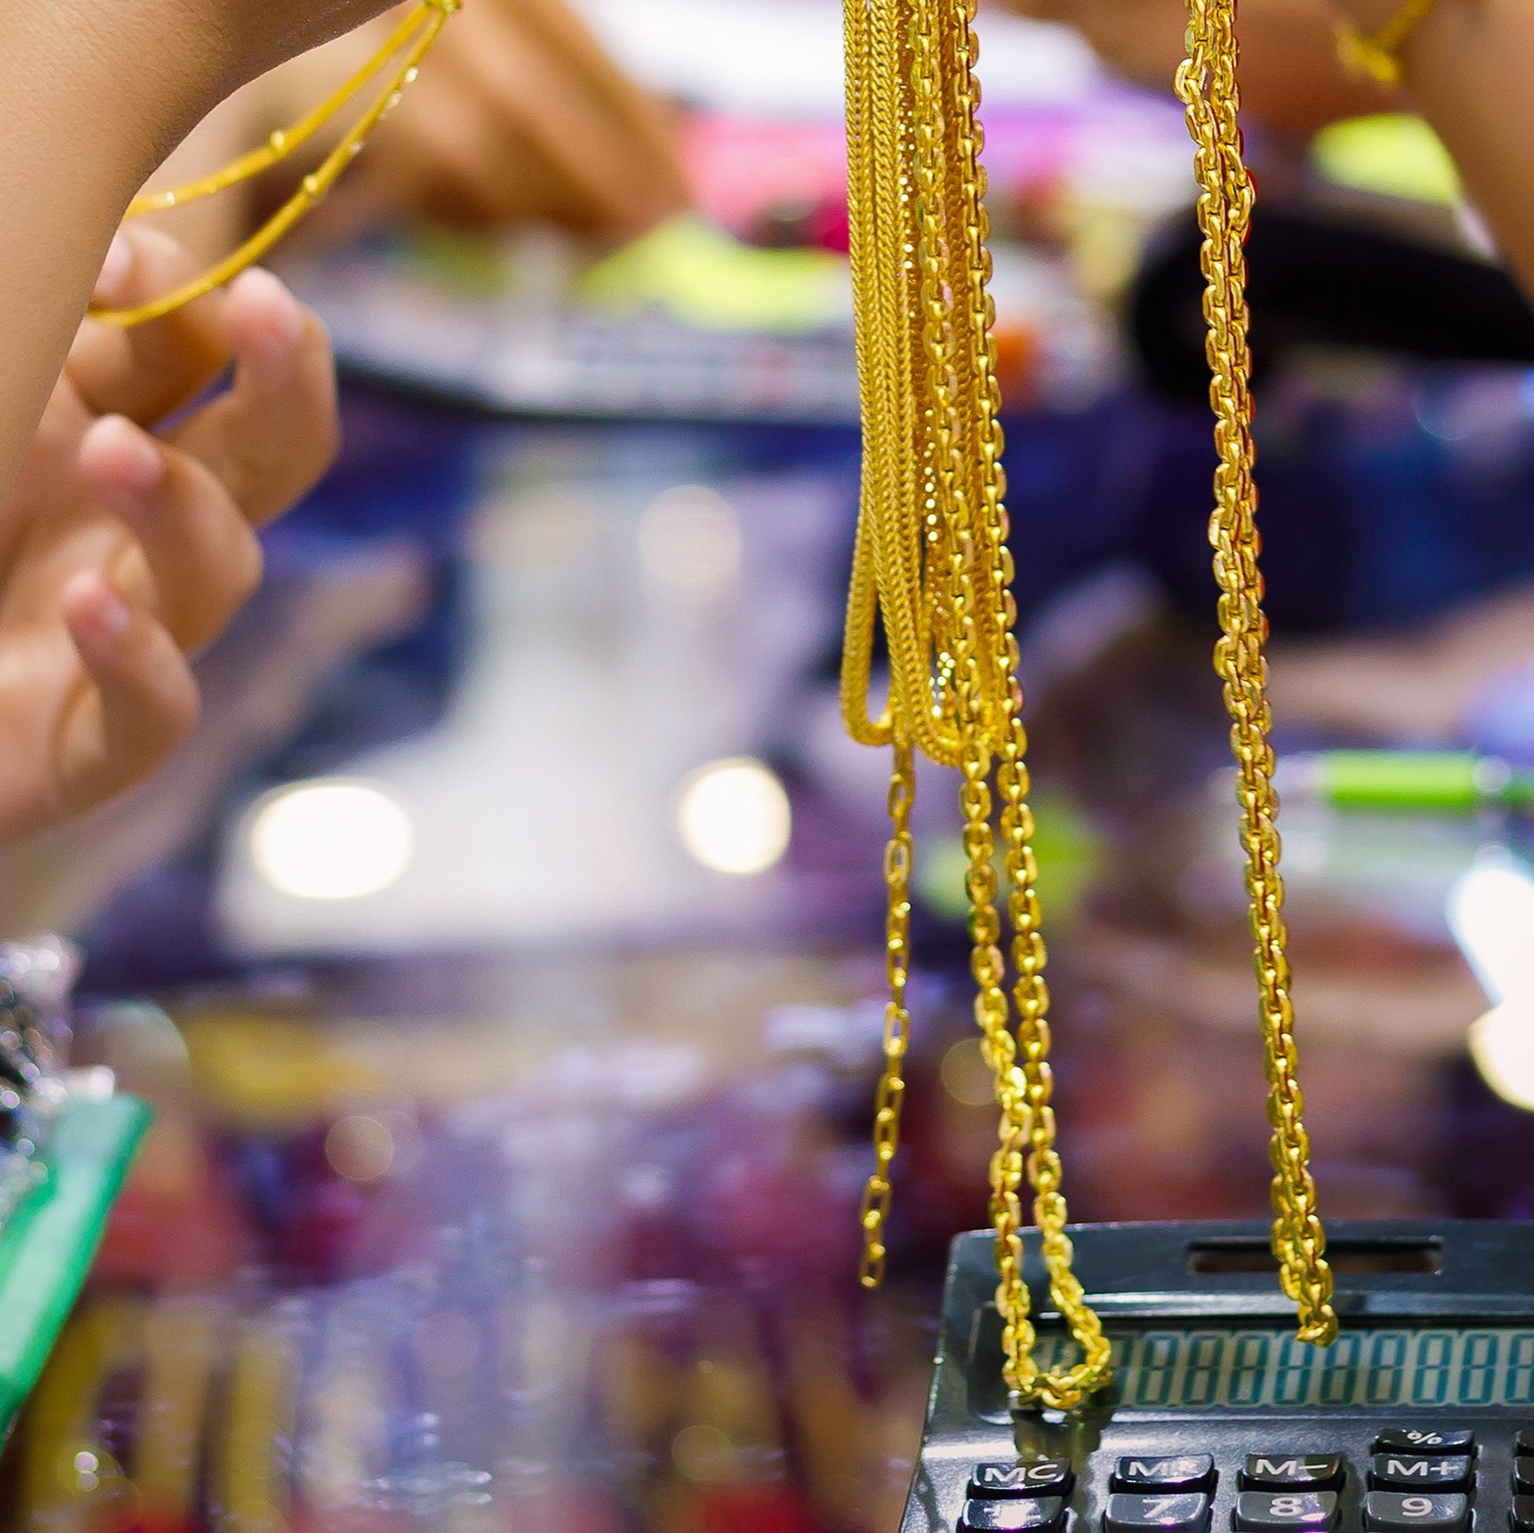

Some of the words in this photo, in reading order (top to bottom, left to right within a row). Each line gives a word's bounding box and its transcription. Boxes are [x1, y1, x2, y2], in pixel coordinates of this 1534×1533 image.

[1406, 1429, 1443, 1445] %
[984, 1464, 1058, 1482] MC
[1128, 1460, 1198, 1477] M
[1386, 1459, 1459, 1477] M+
[1142, 1498, 1179, 1518] 7
[1269, 1497, 1303, 1517] 8
[1401, 1497, 1433, 1517] 9
